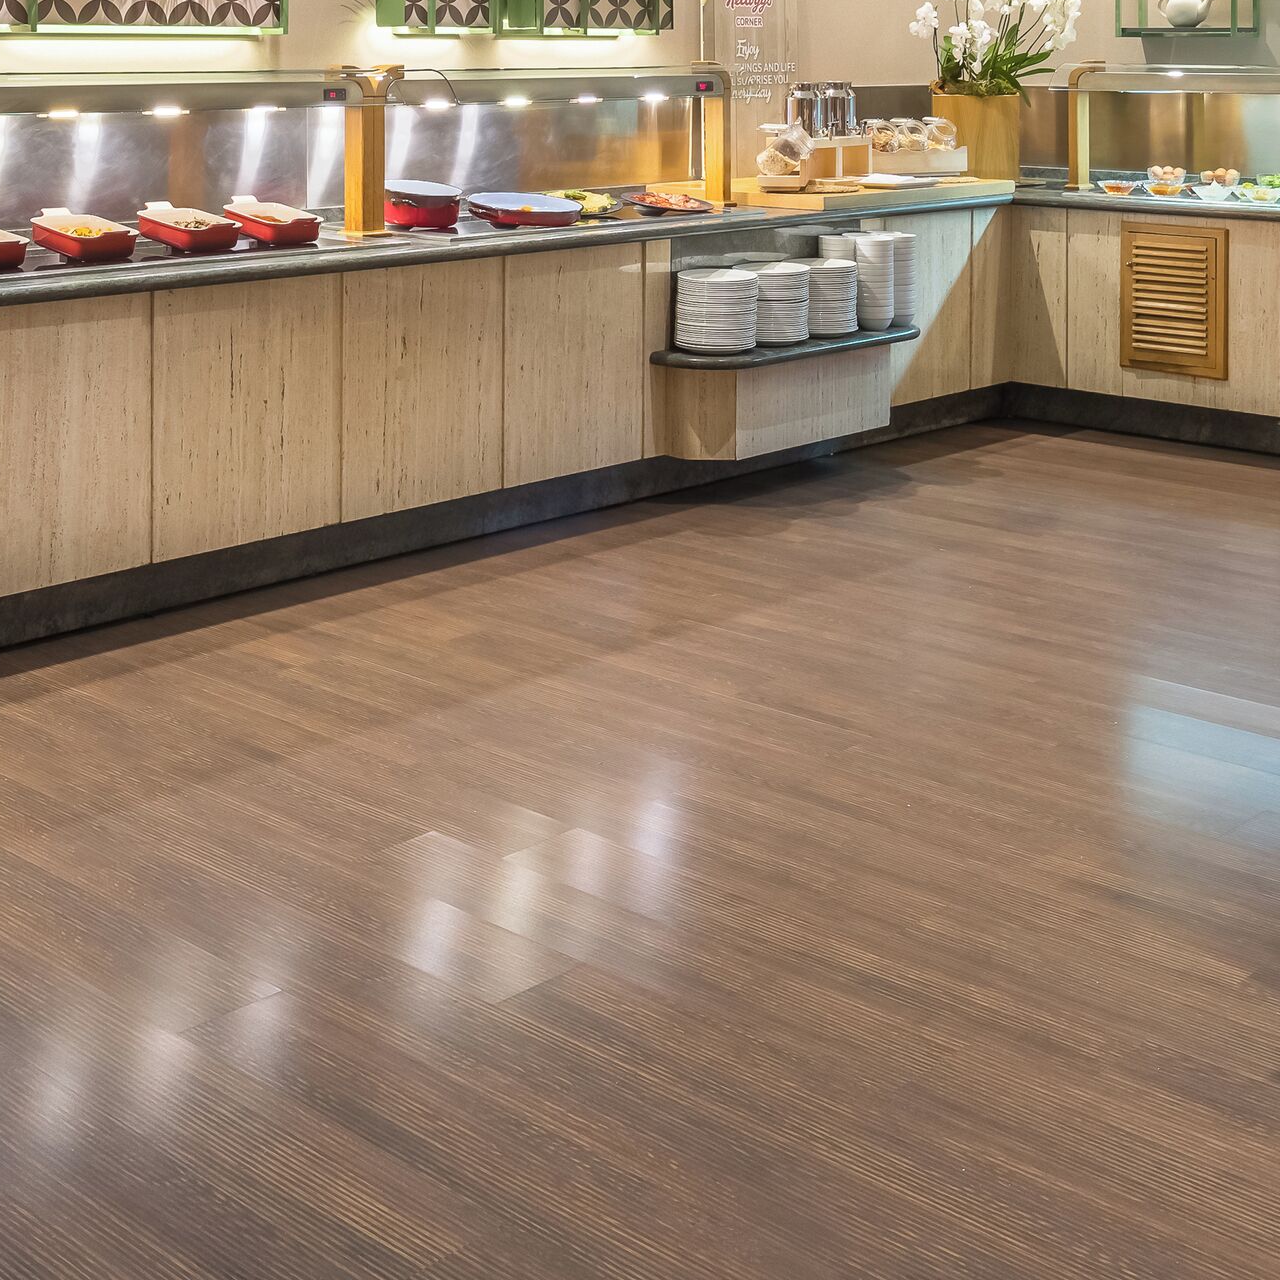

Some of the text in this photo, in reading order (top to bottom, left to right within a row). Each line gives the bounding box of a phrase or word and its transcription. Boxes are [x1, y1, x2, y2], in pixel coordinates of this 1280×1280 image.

[736, 17, 763, 26] CORNER
[736, 39, 760, 60] Enjoy
[763, 62, 780, 72] AND
[781, 62, 796, 72] LIFE
[773, 73, 789, 84] YOU
